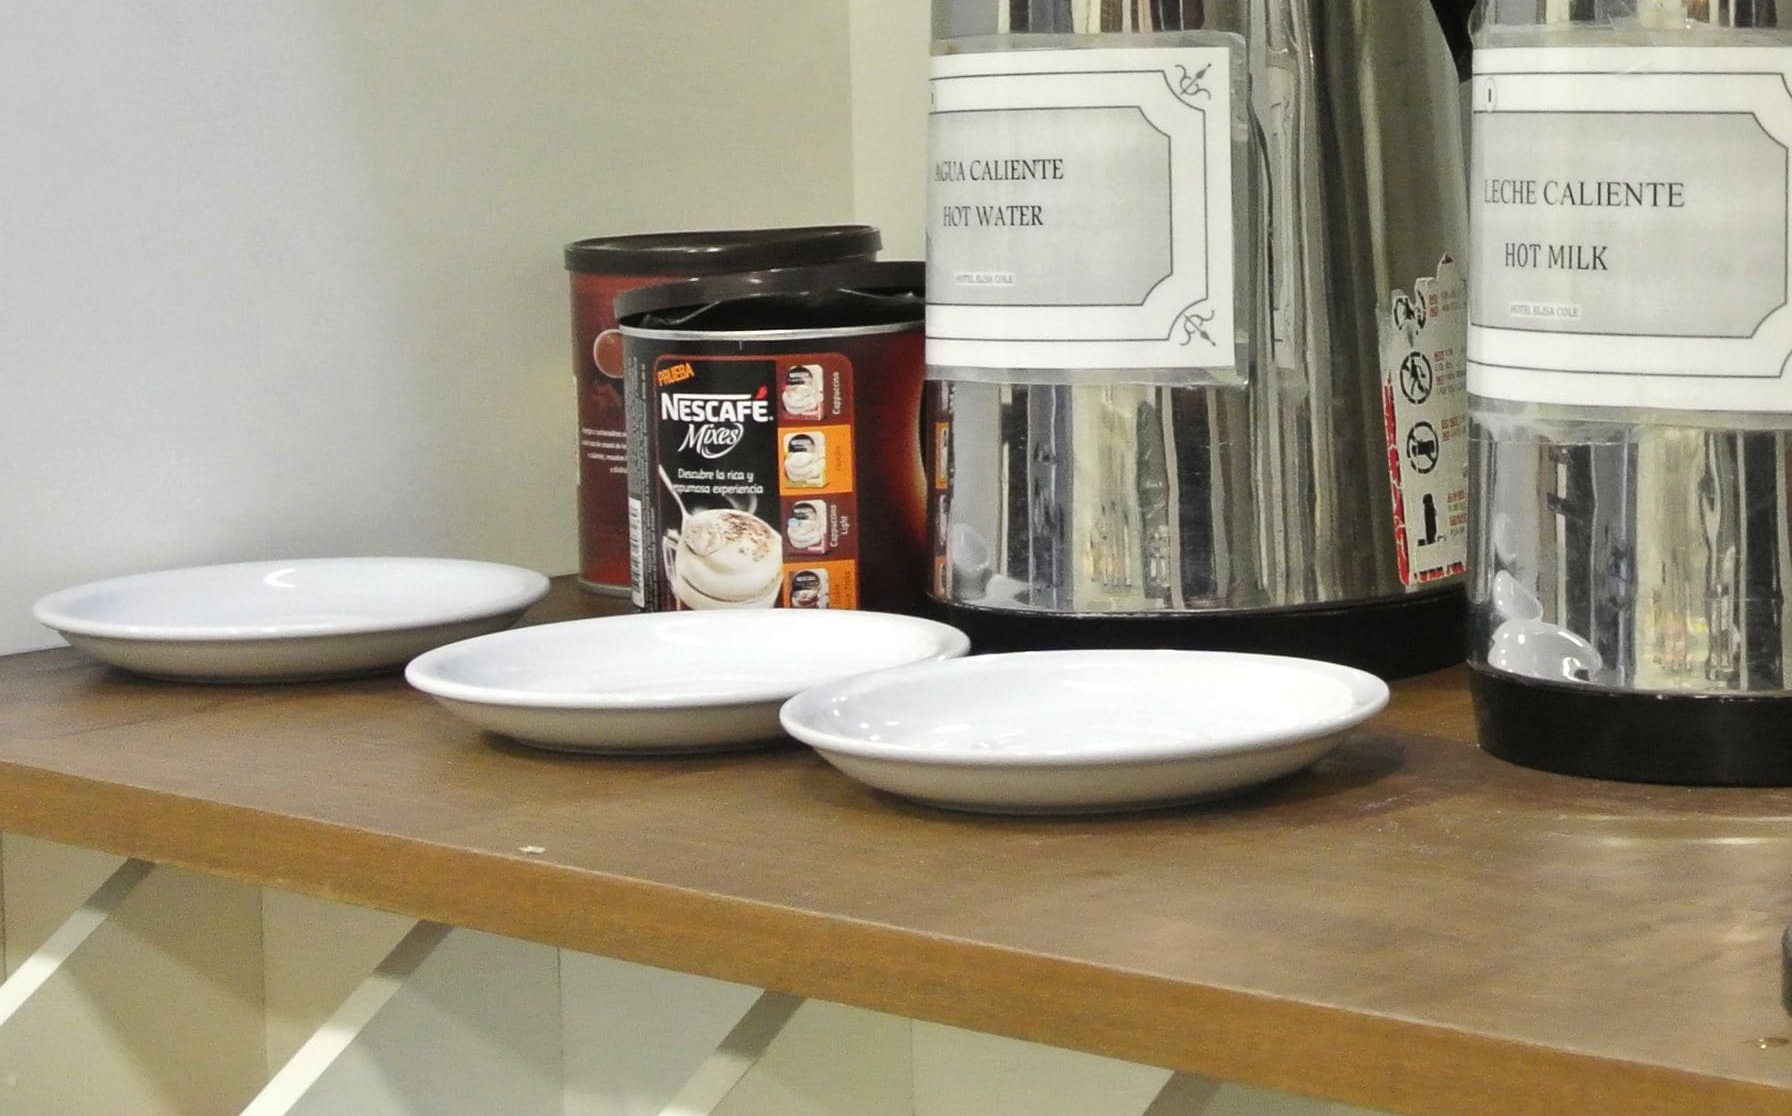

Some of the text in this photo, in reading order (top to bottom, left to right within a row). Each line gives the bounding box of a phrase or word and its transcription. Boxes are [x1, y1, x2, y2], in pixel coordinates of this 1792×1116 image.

[935, 158, 1064, 182] AGUA CALIENTE
[1484, 179, 1685, 208] LECHE CALIENTE
[943, 205, 1043, 227] HOT WATER
[1505, 243, 1608, 271] HOT MILK
[657, 362, 694, 386] PRUEBA
[661, 385, 769, 422] NESCAFÉ
[678, 423, 744, 459] Mixes
[678, 468, 754, 483] Descubre la rica y
[712, 484, 764, 496] experiencia
